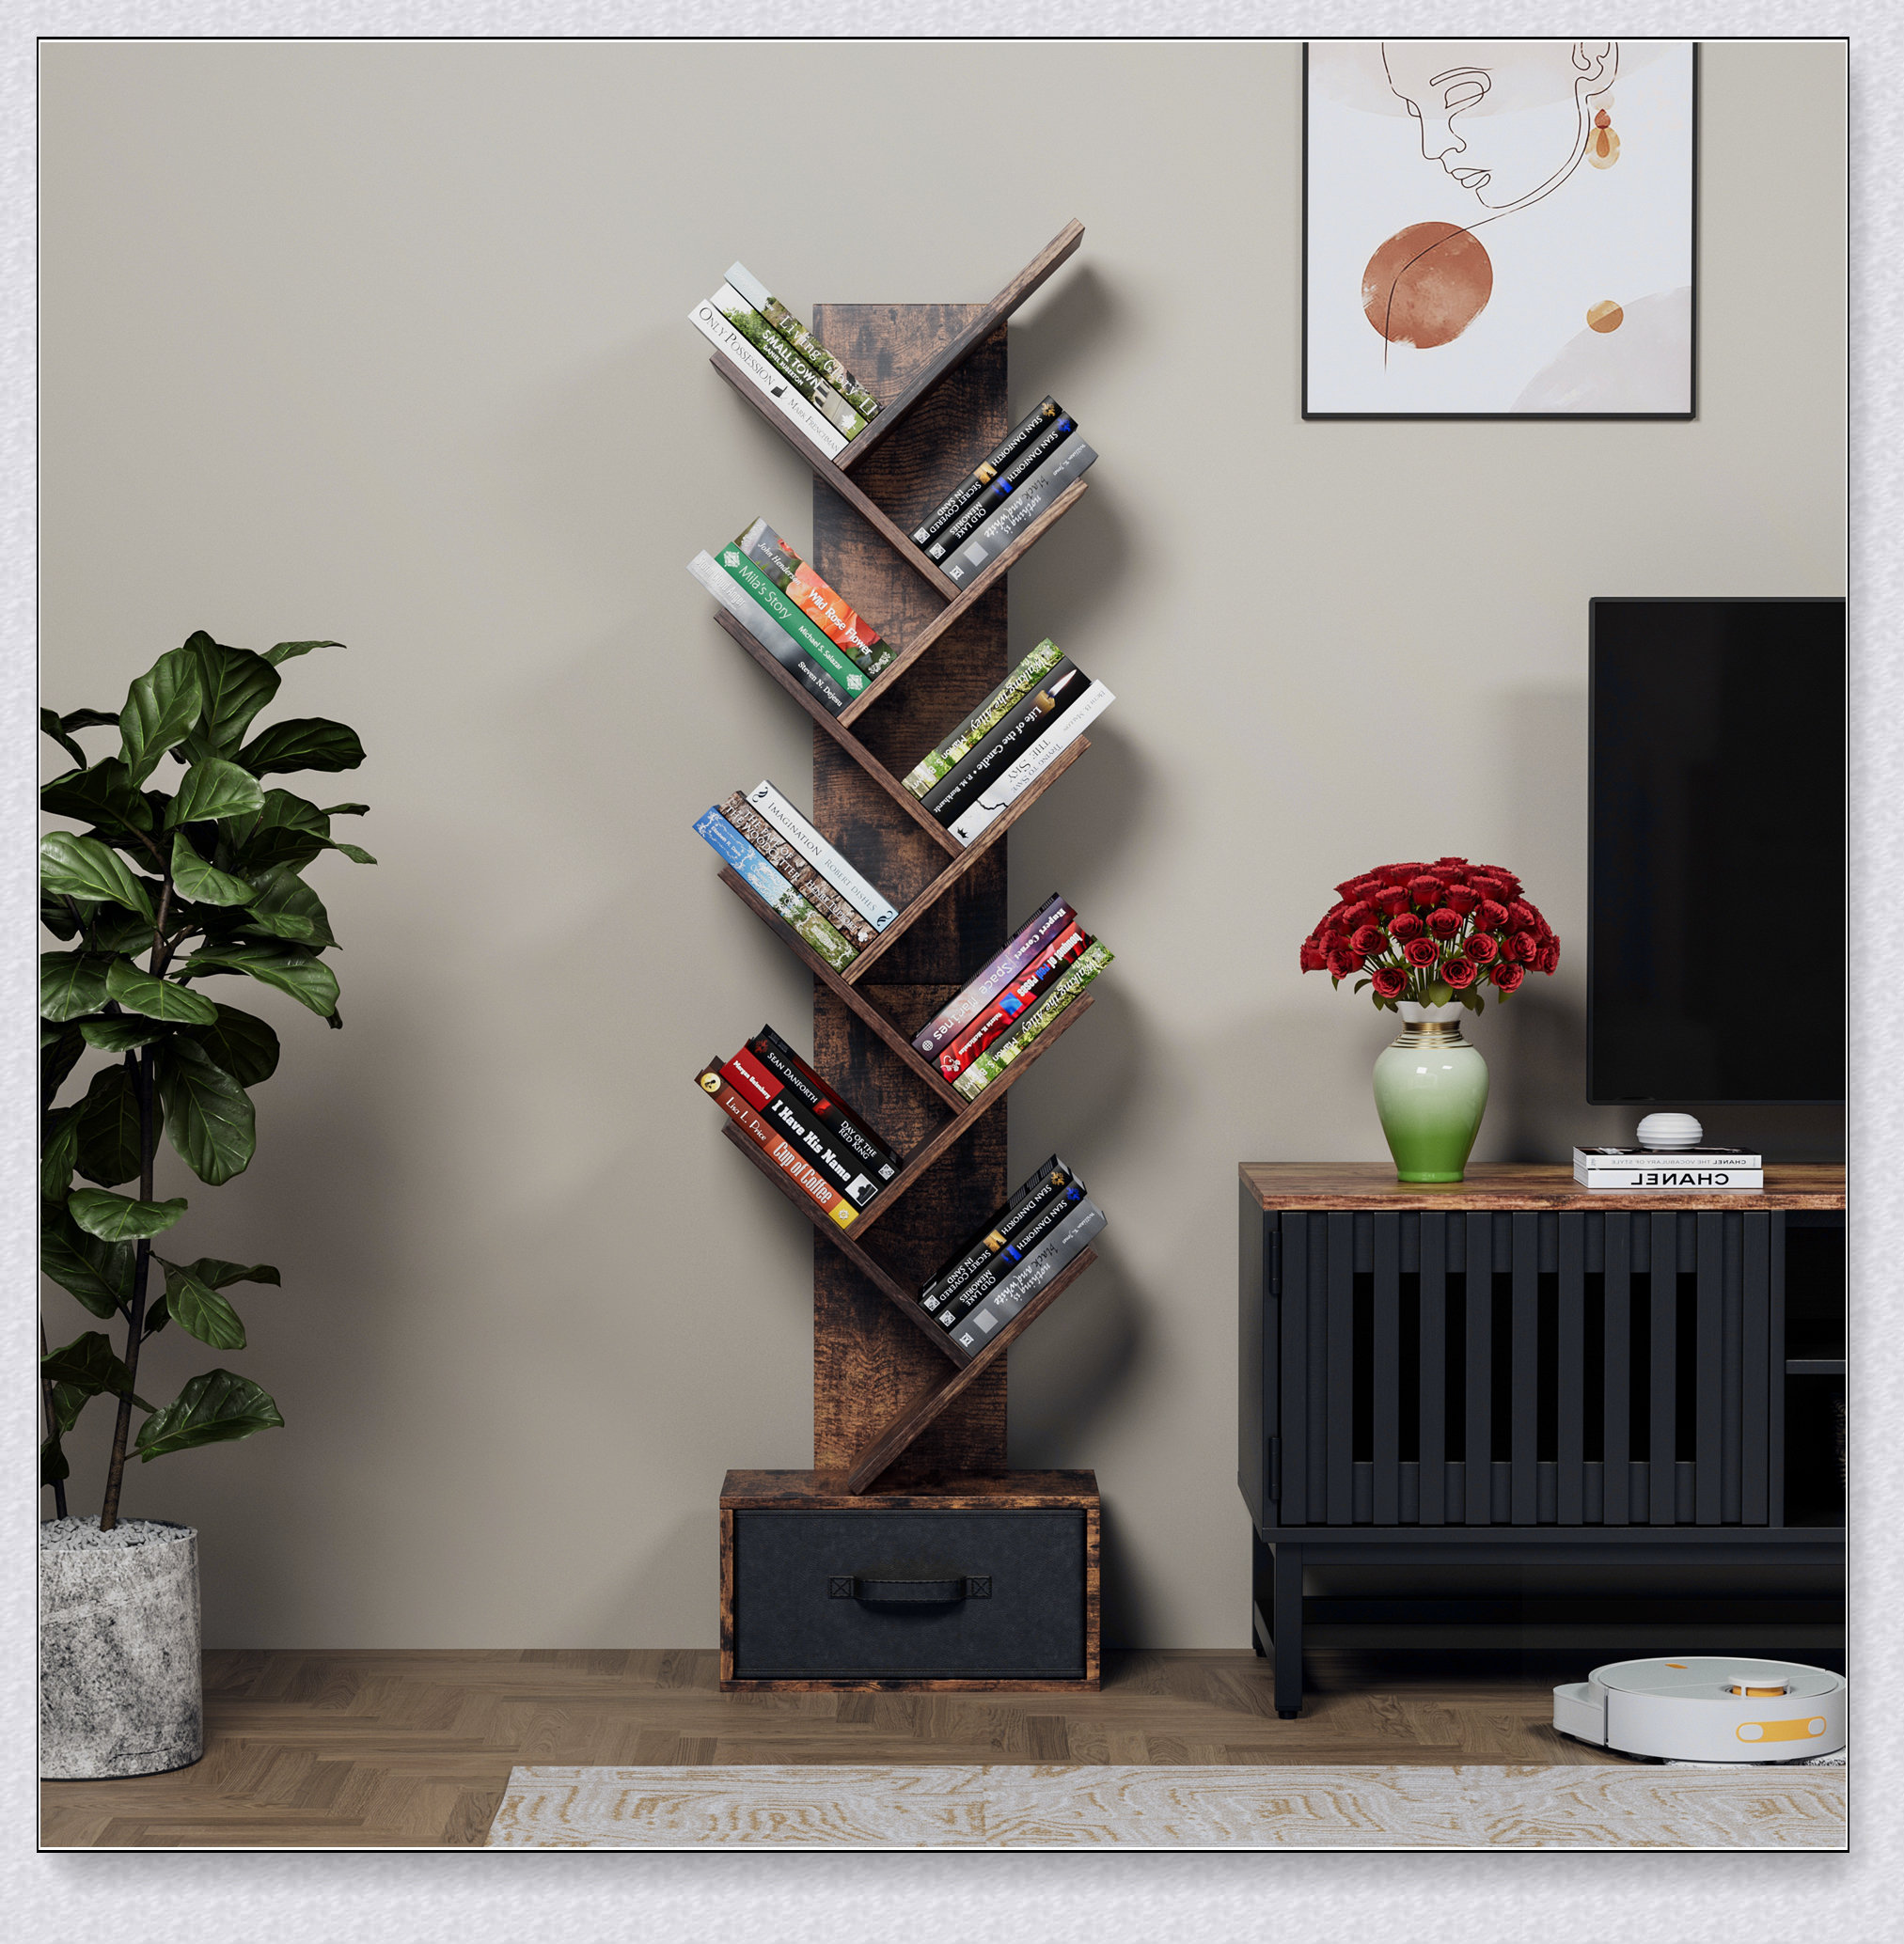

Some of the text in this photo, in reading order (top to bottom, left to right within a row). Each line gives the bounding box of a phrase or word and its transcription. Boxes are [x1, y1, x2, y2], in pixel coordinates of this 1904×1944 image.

[697, 305, 777, 387] ONLY POSSESSION
[761, 328, 822, 389] SMALL TOWN
[763, 343, 781, 363] DANIEL
[778, 314, 860, 399] Living Glory
[991, 415, 1043, 466] SEAN DANFORTH
[1006, 431, 1058, 482] SEAN DANFORTH
[928, 481, 981, 534] SECRET COVERED
[936, 496, 955, 517] SAND
[949, 501, 982, 535] MEMORIES
[954, 507, 986, 539] OLD LAKE
[982, 475, 1048, 541] black and white
[1009, 493, 1044, 528] nothing
[757, 541, 802, 586] John Henderson
[723, 584, 748, 609] Anger
[738, 564, 794, 621] Mila's Story
[807, 589, 873, 656] Wild Rose Flower
[797, 624, 821, 648] Michael
[823, 650, 843, 670] Salazar
[797, 660, 818, 682] Steven
[822, 685, 843, 707] Dejesu
[968, 655, 1046, 732] Walking the Alley
[1000, 729, 1017, 745] the
[1022, 705, 1042, 724] Life
[974, 743, 1005, 772] Candle
[1004, 737, 1051, 784] THE SKY
[1036, 743, 1062, 767] TRYING
[932, 786, 961, 814] Burkhardt
[725, 806, 745, 824] THE
[740, 822, 802, 881] WOODCUTTER
[742, 809, 794, 860] THE FATE OF
[765, 802, 824, 856] IMAGINATION
[823, 858, 854, 887] ROBERT
[850, 886, 877, 912] DISHES
[805, 878, 831, 903] HENRY
[1013, 906, 1066, 960] Rupert Cornet
[1052, 931, 1083, 961] bouquet
[976, 961, 1013, 996] Space
[1015, 974, 1040, 997] roses
[1033, 963, 1051, 980] red
[1018, 957, 1098, 1035] Walking the Alley
[931, 996, 979, 1042] Marines
[766, 1051, 818, 1103] SEAN DANFORTH
[725, 1096, 743, 1115] Lisa
[748, 1120, 769, 1141] Price
[841, 1120, 856, 1136] DAY
[861, 1141, 877, 1157] THE
[778, 1105, 808, 1136] Have
[802, 1131, 825, 1153] His
[820, 1149, 854, 1182] Name
[838, 1128, 870, 1160] RED KING
[770, 1141, 797, 1168] Cup
[799, 1168, 835, 1204] Coffee
[1033, 1184, 1051, 1201] SEAN
[1000, 1199, 1035, 1234] DANFORTH
[1015, 1199, 1067, 1250] SEAN DANFORTH
[938, 1249, 991, 1301] SECRET COVERED
[946, 1264, 966, 1284] SAND
[958, 1269, 993, 1302] MEMORIES
[964, 1275, 996, 1307] OLD LAKE
[991, 1242, 1058, 1308] black and white
[1017, 1261, 1053, 1295] nothing
